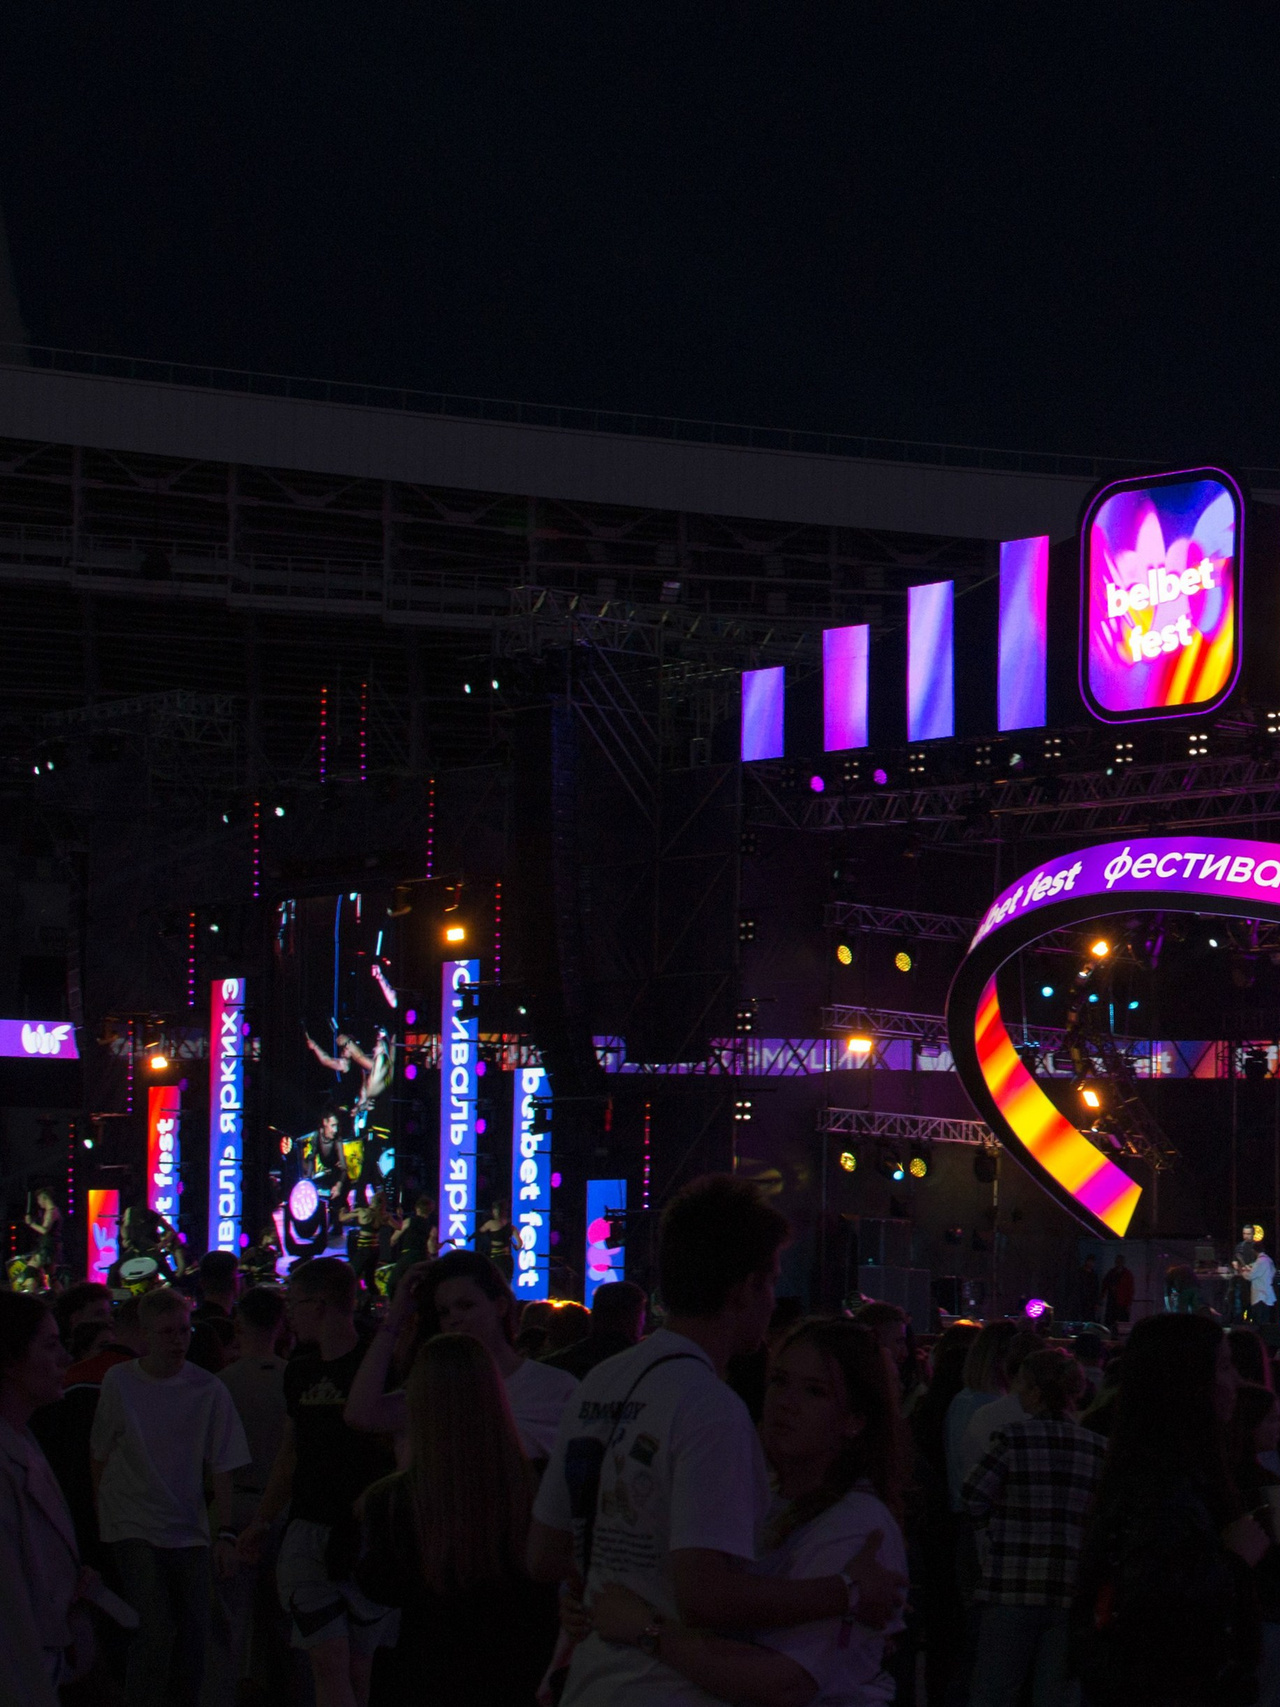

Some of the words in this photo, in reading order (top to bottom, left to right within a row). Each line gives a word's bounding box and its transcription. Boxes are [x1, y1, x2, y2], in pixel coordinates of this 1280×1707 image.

[1106, 558, 1215, 618] belbet
[1129, 614, 1193, 662] fest
[1021, 861, 1083, 907] fest
[518, 1212, 543, 1287] fest
